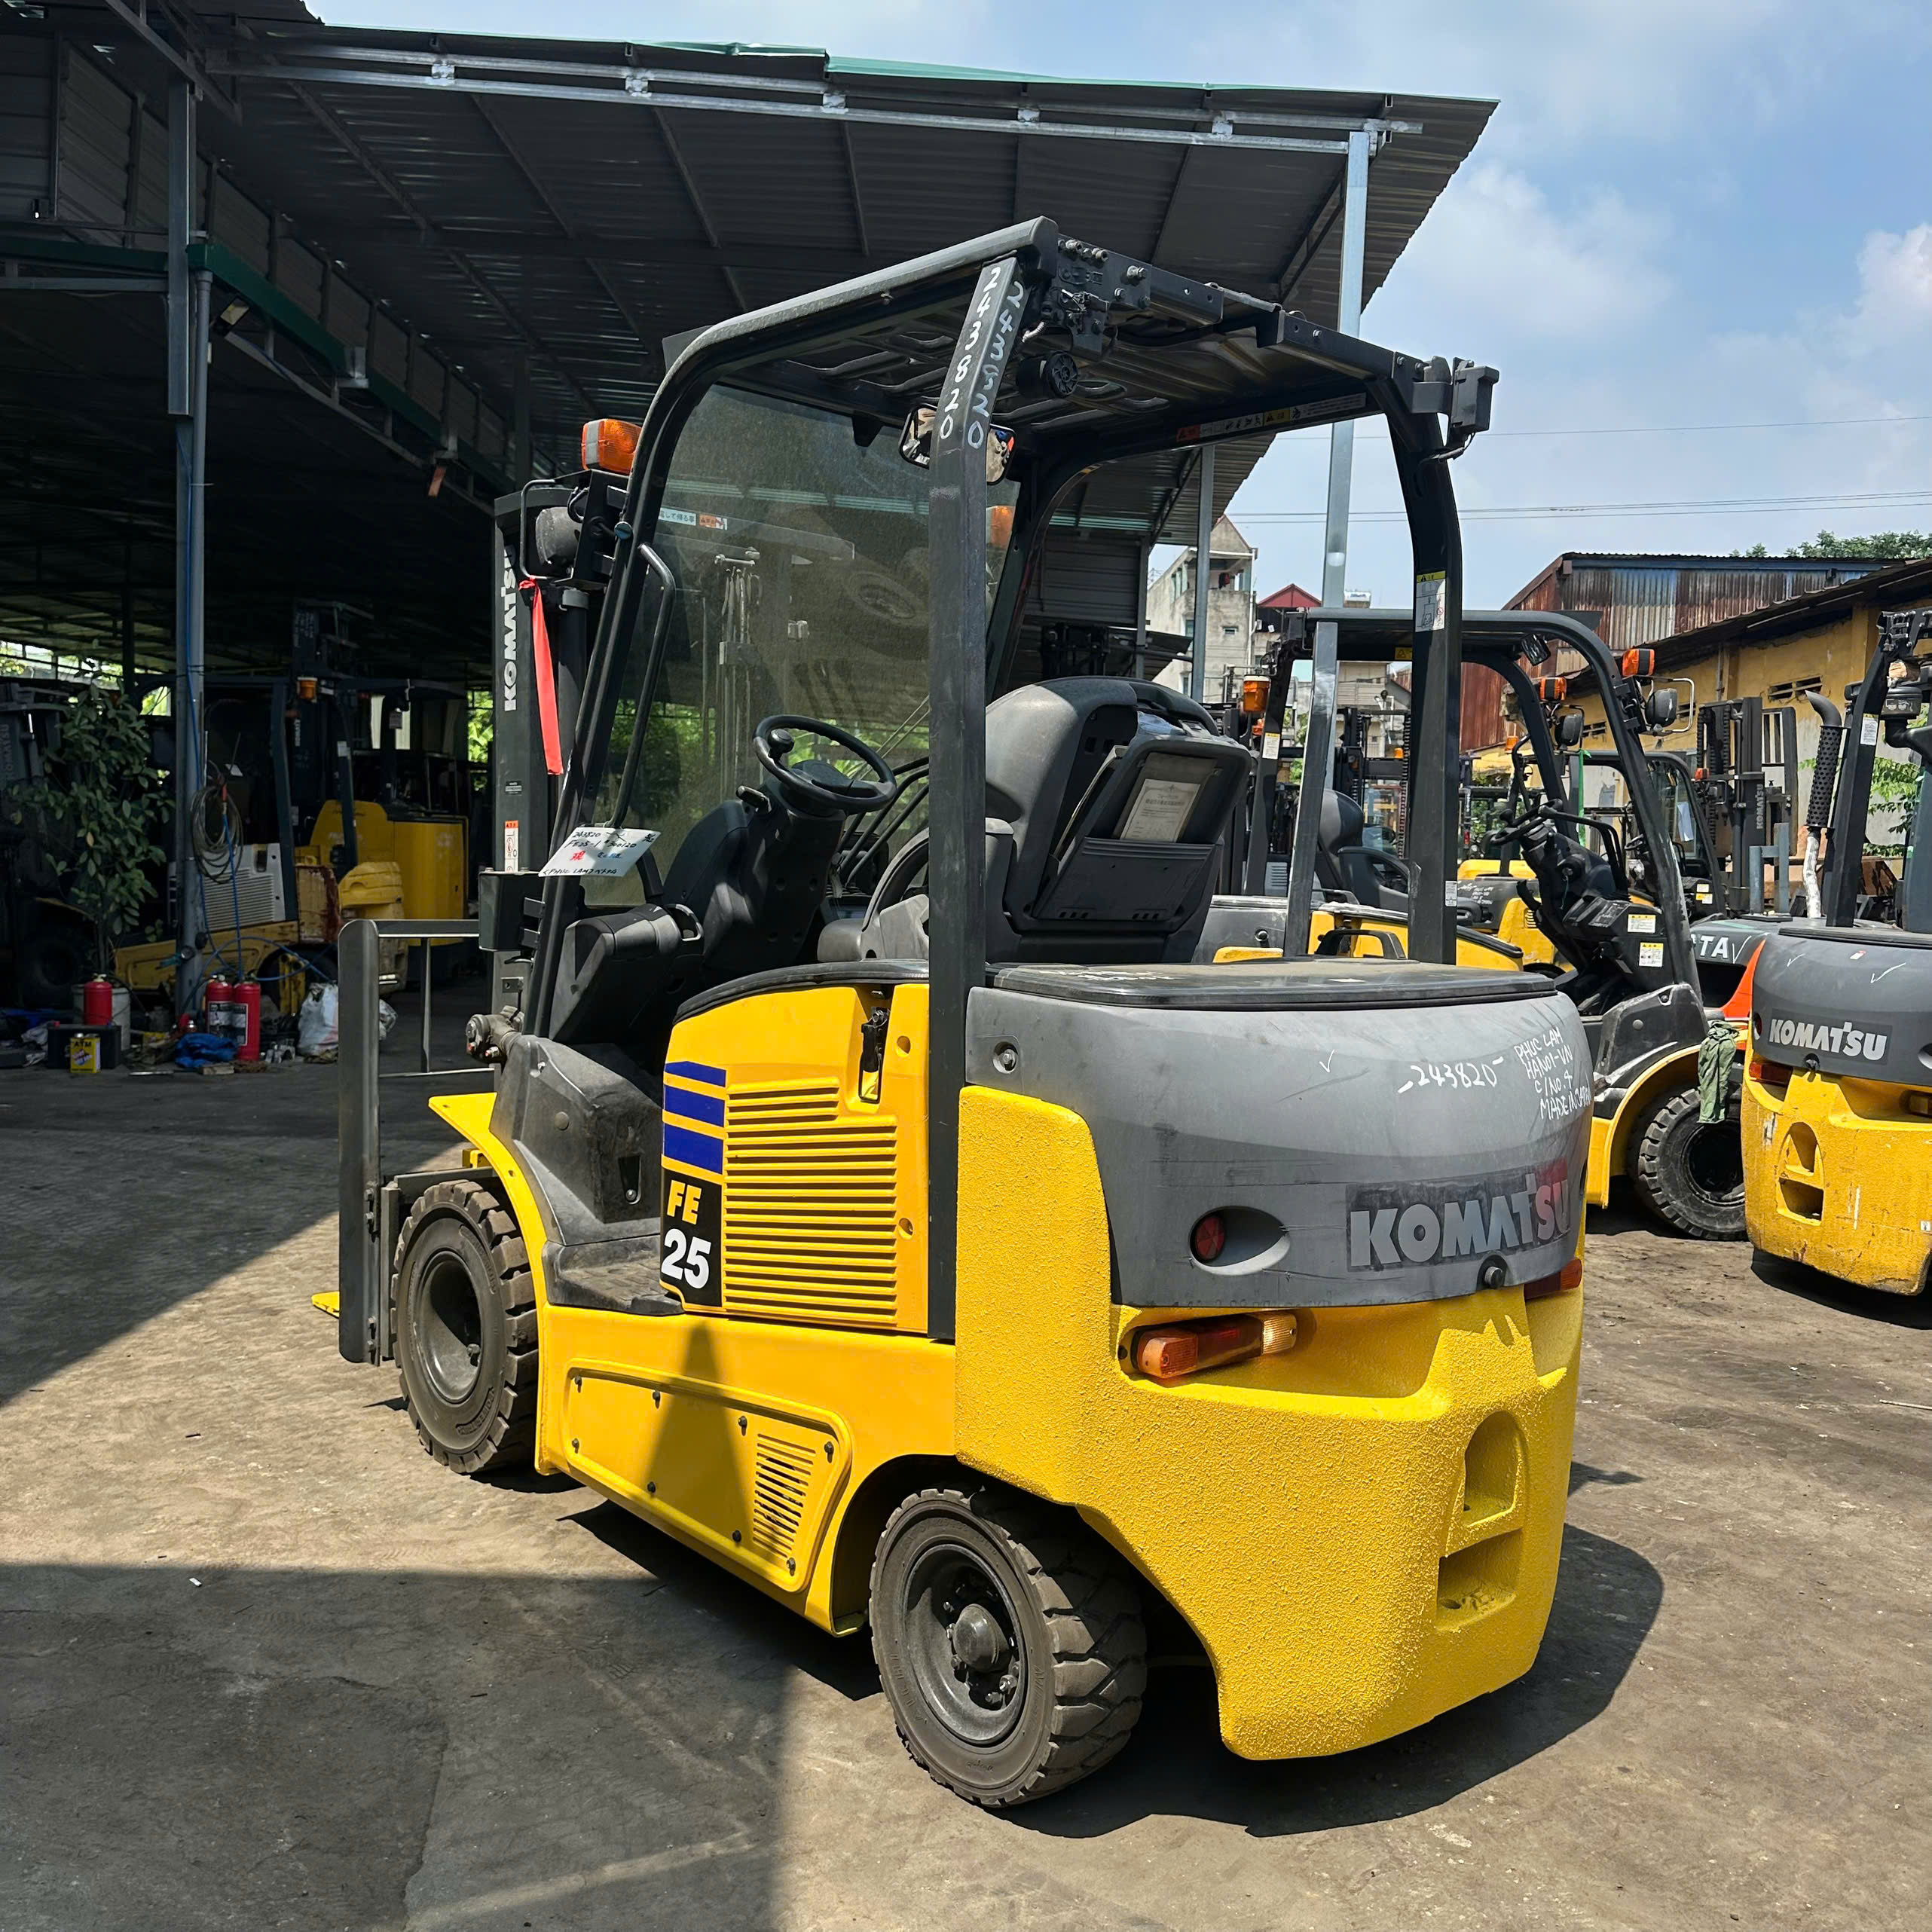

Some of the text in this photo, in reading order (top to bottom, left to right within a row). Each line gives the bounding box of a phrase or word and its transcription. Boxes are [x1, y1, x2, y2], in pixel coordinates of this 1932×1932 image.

[940, 266, 1001, 439] 243820
[1755, 784, 1764, 830] KOMATSU
[1691, 934, 1729, 959] TA
[1769, 1019, 1888, 1061] KOMATSU
[666, 1179, 702, 1225] FE
[1350, 1172, 1571, 1267] KOMATSU
[661, 1228, 711, 1289] 25
